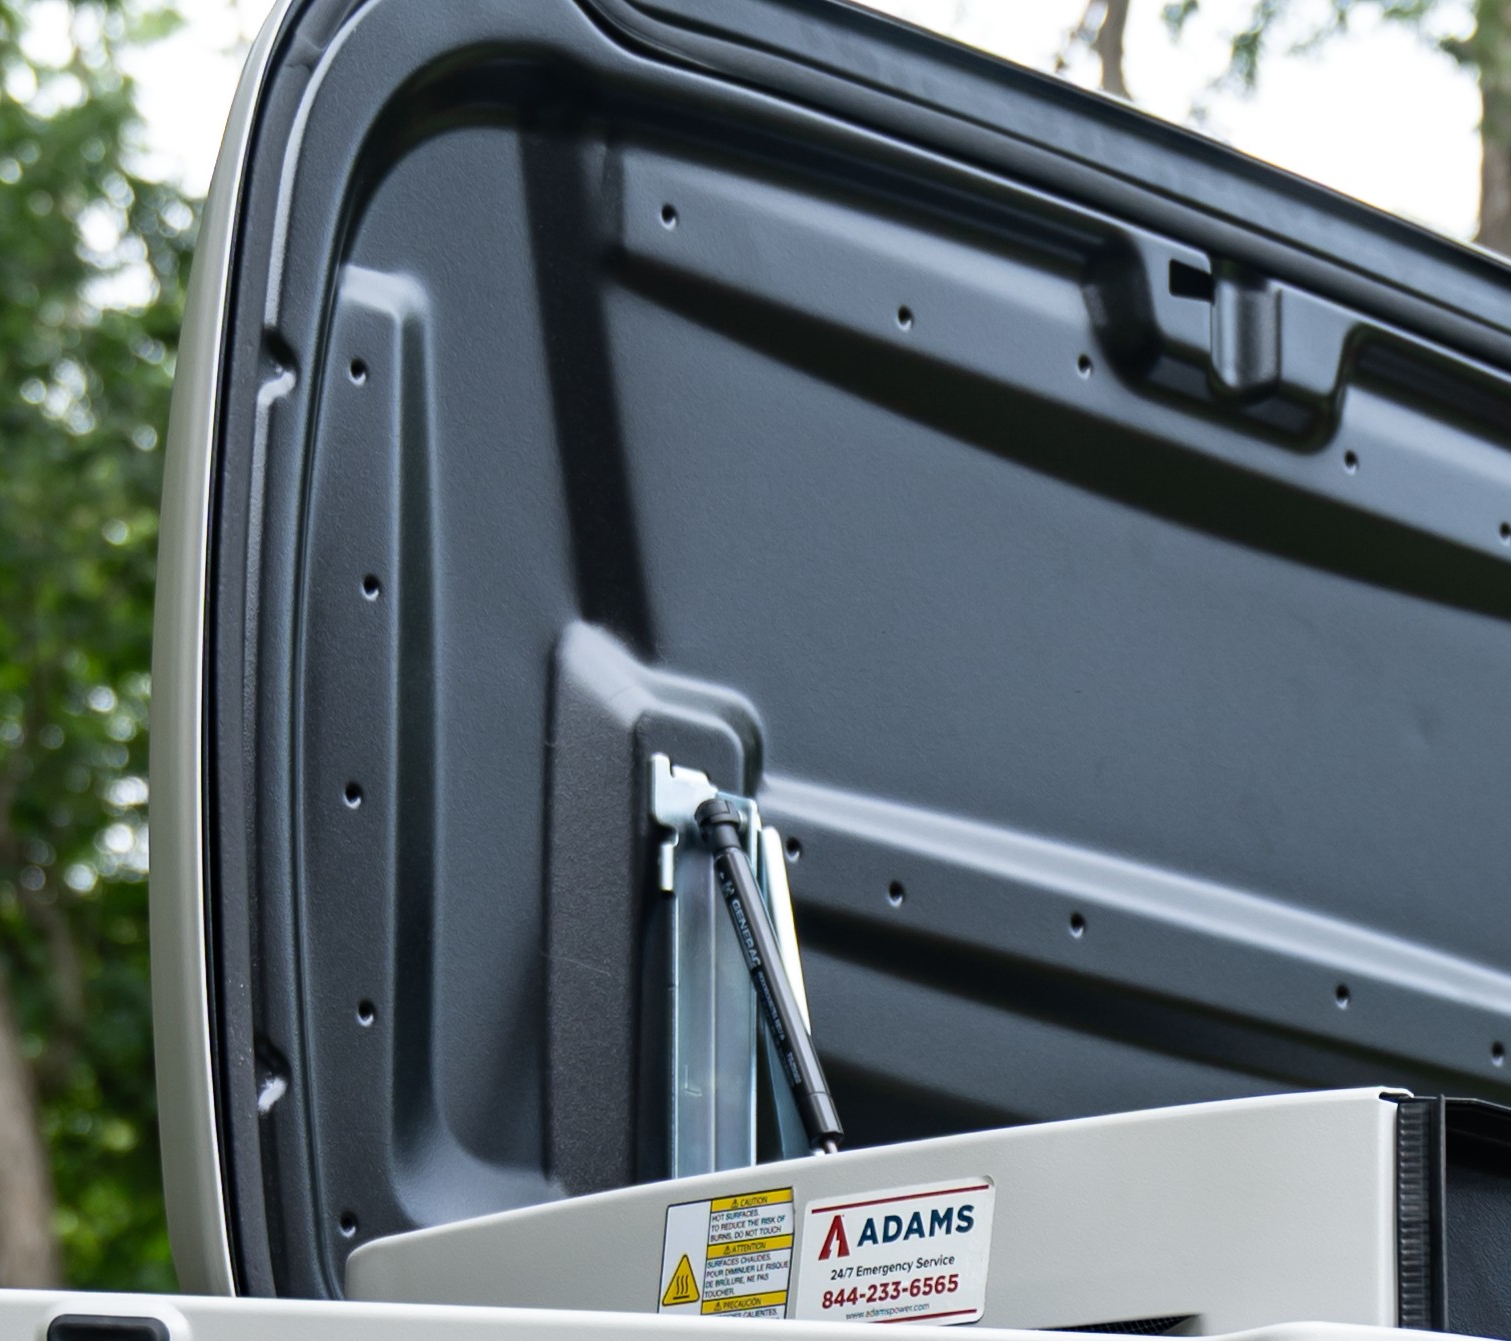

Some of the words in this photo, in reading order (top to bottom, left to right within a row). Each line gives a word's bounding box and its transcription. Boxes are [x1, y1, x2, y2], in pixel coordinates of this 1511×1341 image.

[731, 898, 761, 966] GENERAC
[740, 1196, 768, 1207] CAUTION
[711, 1224, 719, 1232] TO
[721, 1220, 746, 1231] REDUCE
[747, 1218, 759, 1226] THE
[761, 1216, 775, 1225] RISK
[777, 1214, 786, 1222] OF
[712, 1213, 725, 1222] HOT
[857, 1204, 974, 1247] ADAMS
[734, 1231, 744, 1239] DO
[745, 1228, 758, 1238] NOT
[732, 1242, 767, 1253] ATTENTION
[706, 1269, 724, 1278] POUR
[765, 1260, 789, 1271] RISQUE
[707, 1256, 739, 1268] SURFACES
[830, 1267, 854, 1280] 24/7
[856, 1260, 913, 1277] Emergency
[916, 1254, 955, 1269] Service
[705, 1280, 713, 1288] DE
[757, 1273, 769, 1281] PAS
[822, 1273, 959, 1310] 844-233-6565
[723, 1297, 762, 1309] PRECAUCIÓN
[846, 1302, 930, 1320] www.adamspower.com
